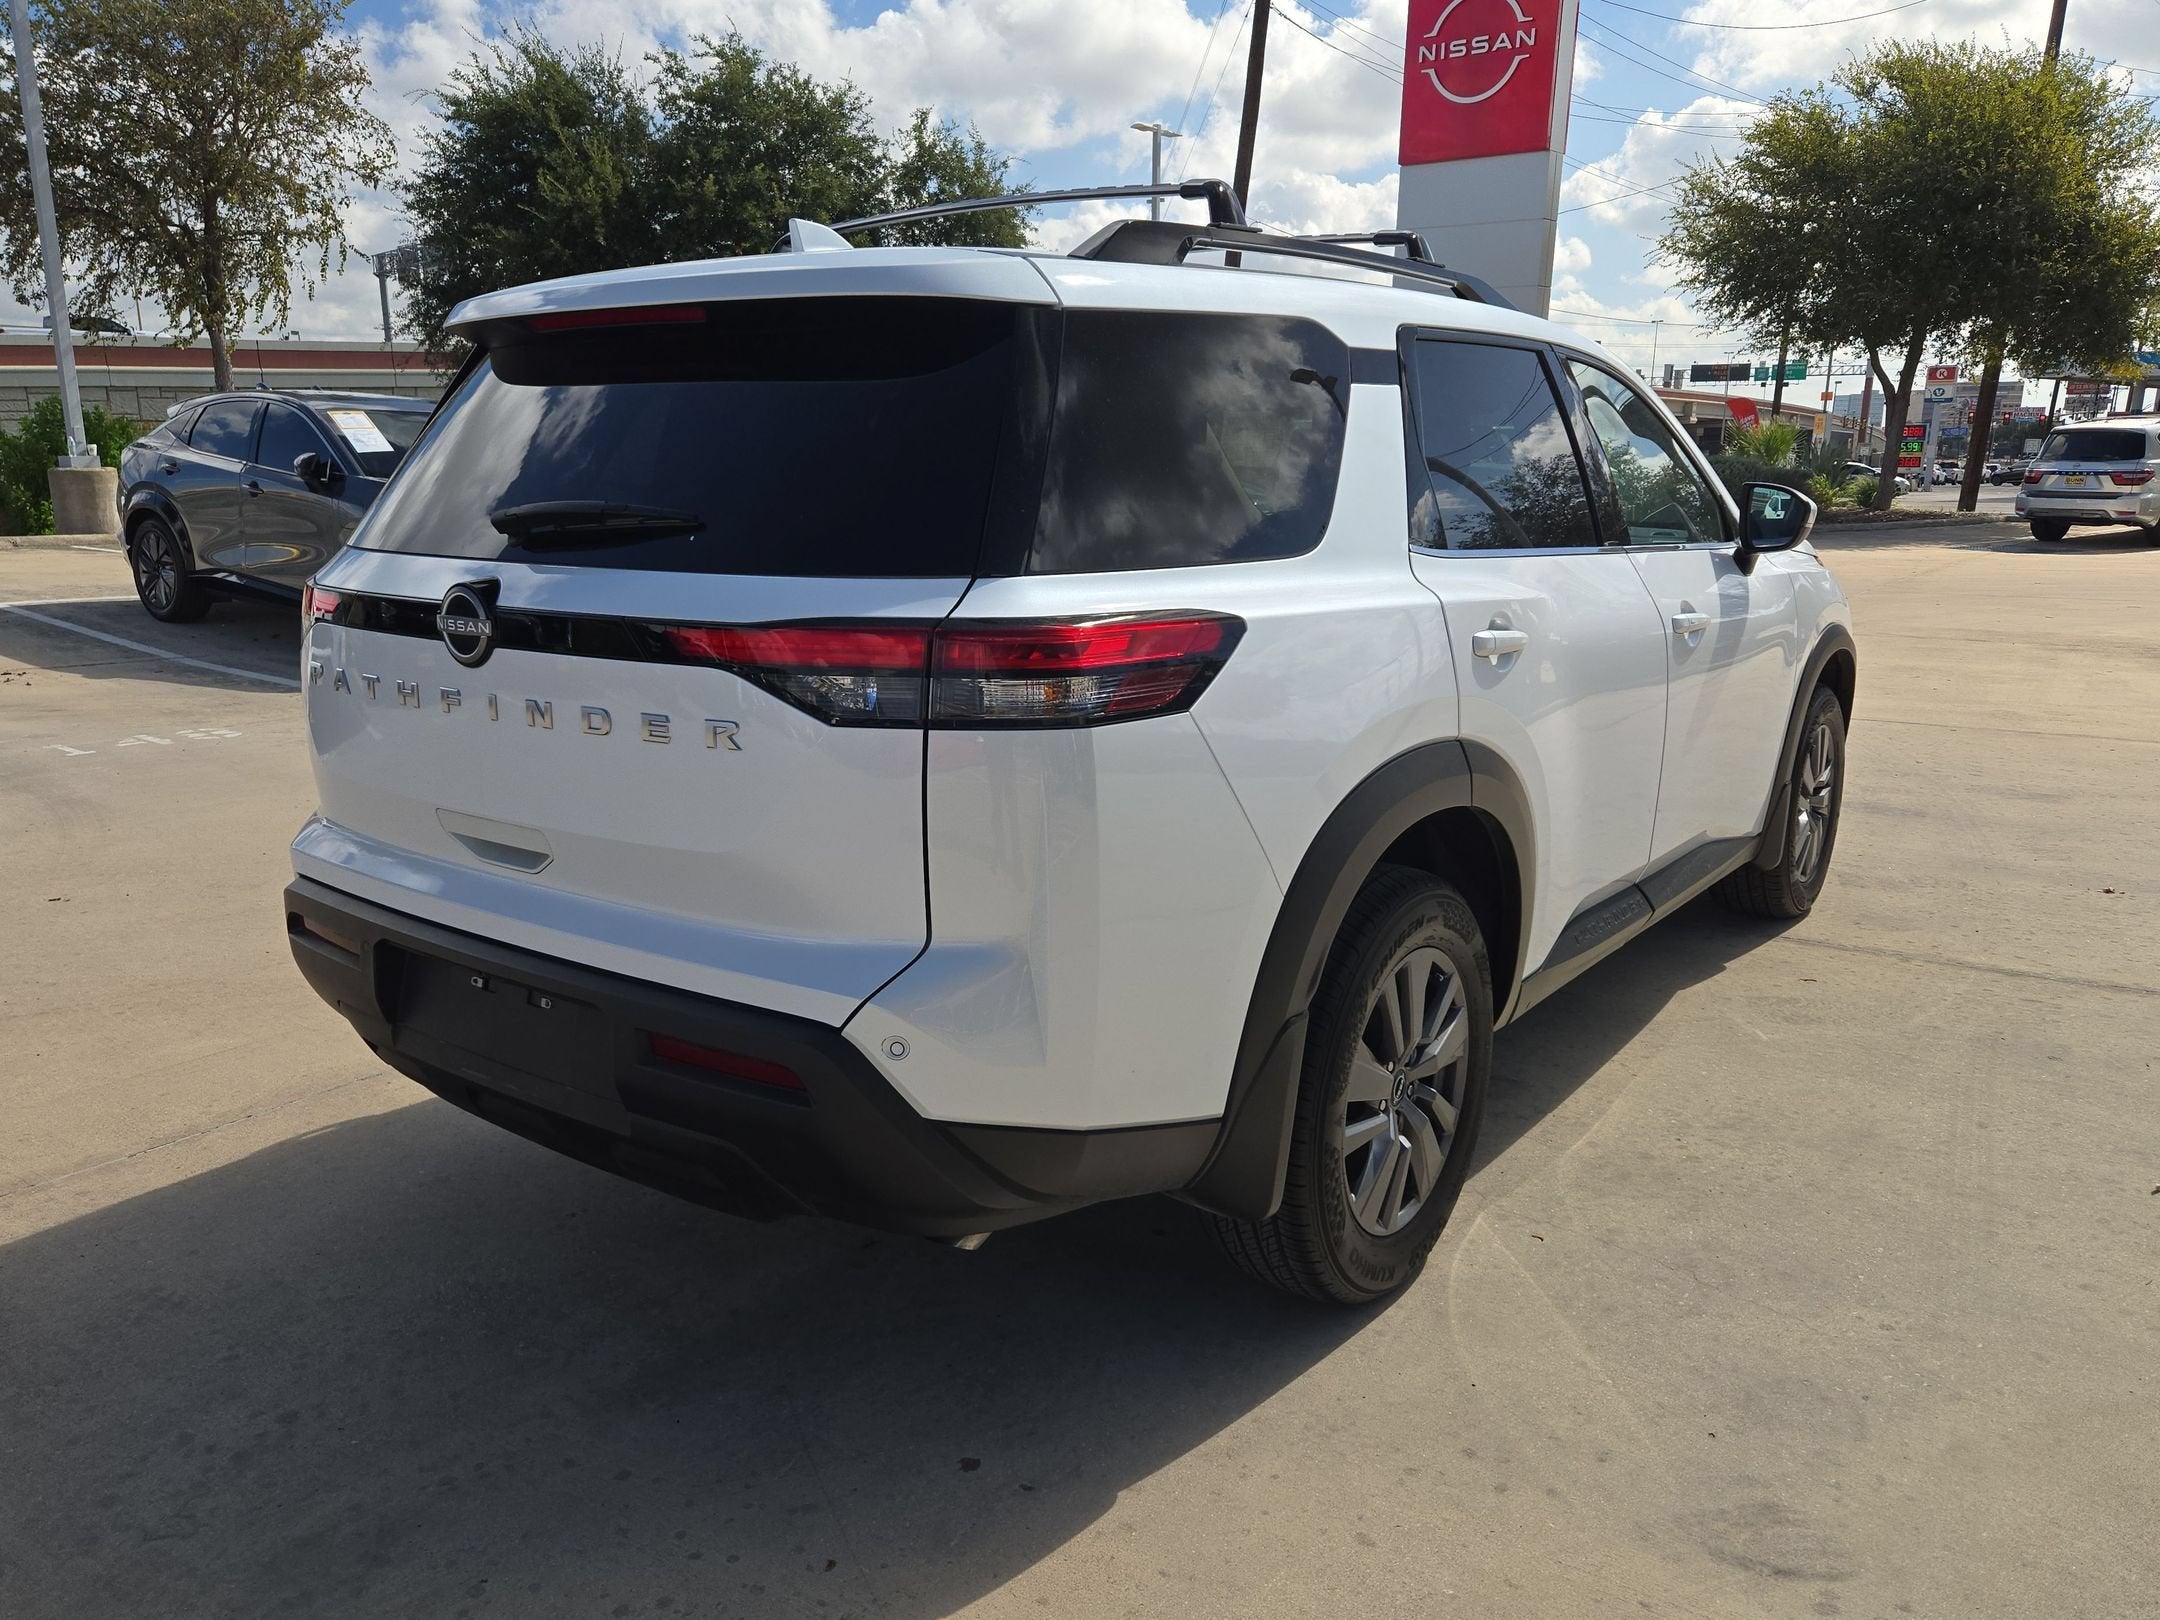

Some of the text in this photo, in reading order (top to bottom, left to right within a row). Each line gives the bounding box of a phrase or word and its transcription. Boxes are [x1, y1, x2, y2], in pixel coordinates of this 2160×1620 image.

[1418, 28, 1536, 63] NISSAN
[437, 616, 489, 633] NISSAN
[309, 660, 744, 752] PATHFINDER
